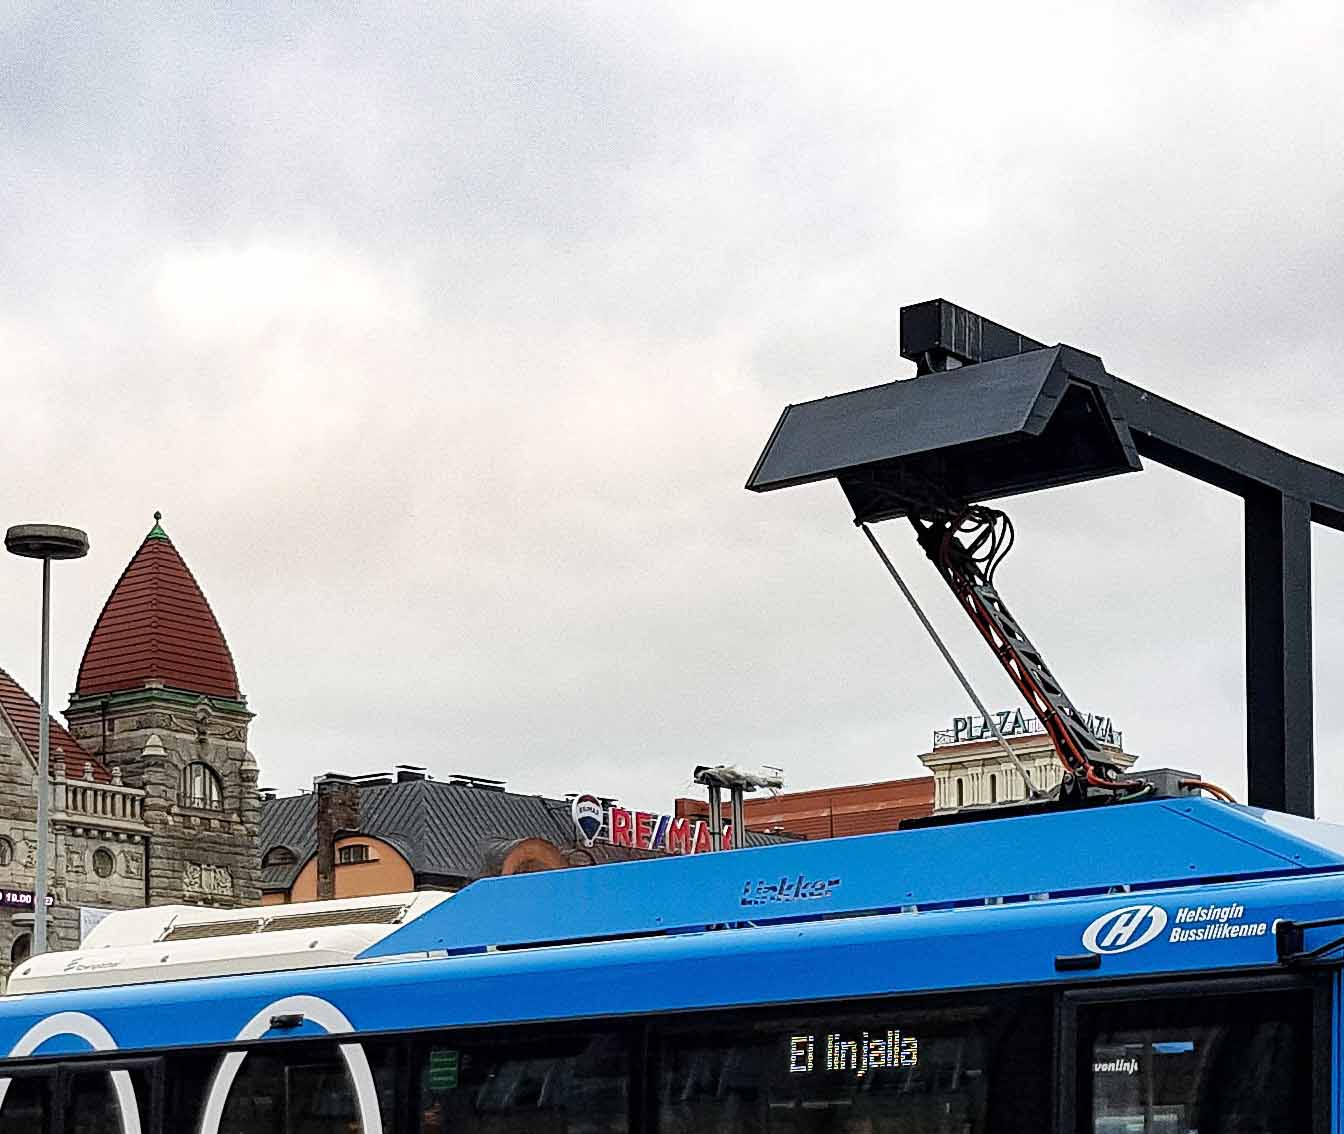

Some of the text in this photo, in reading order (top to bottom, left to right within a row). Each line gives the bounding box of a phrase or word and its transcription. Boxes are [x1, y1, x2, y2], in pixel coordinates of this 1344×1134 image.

[953, 708, 1027, 742] PLAZA
[1175, 903, 1244, 924] Helsingin
[1168, 922, 1267, 943] Bussiliikenne
[790, 1030, 918, 1078] Ei linjalla
